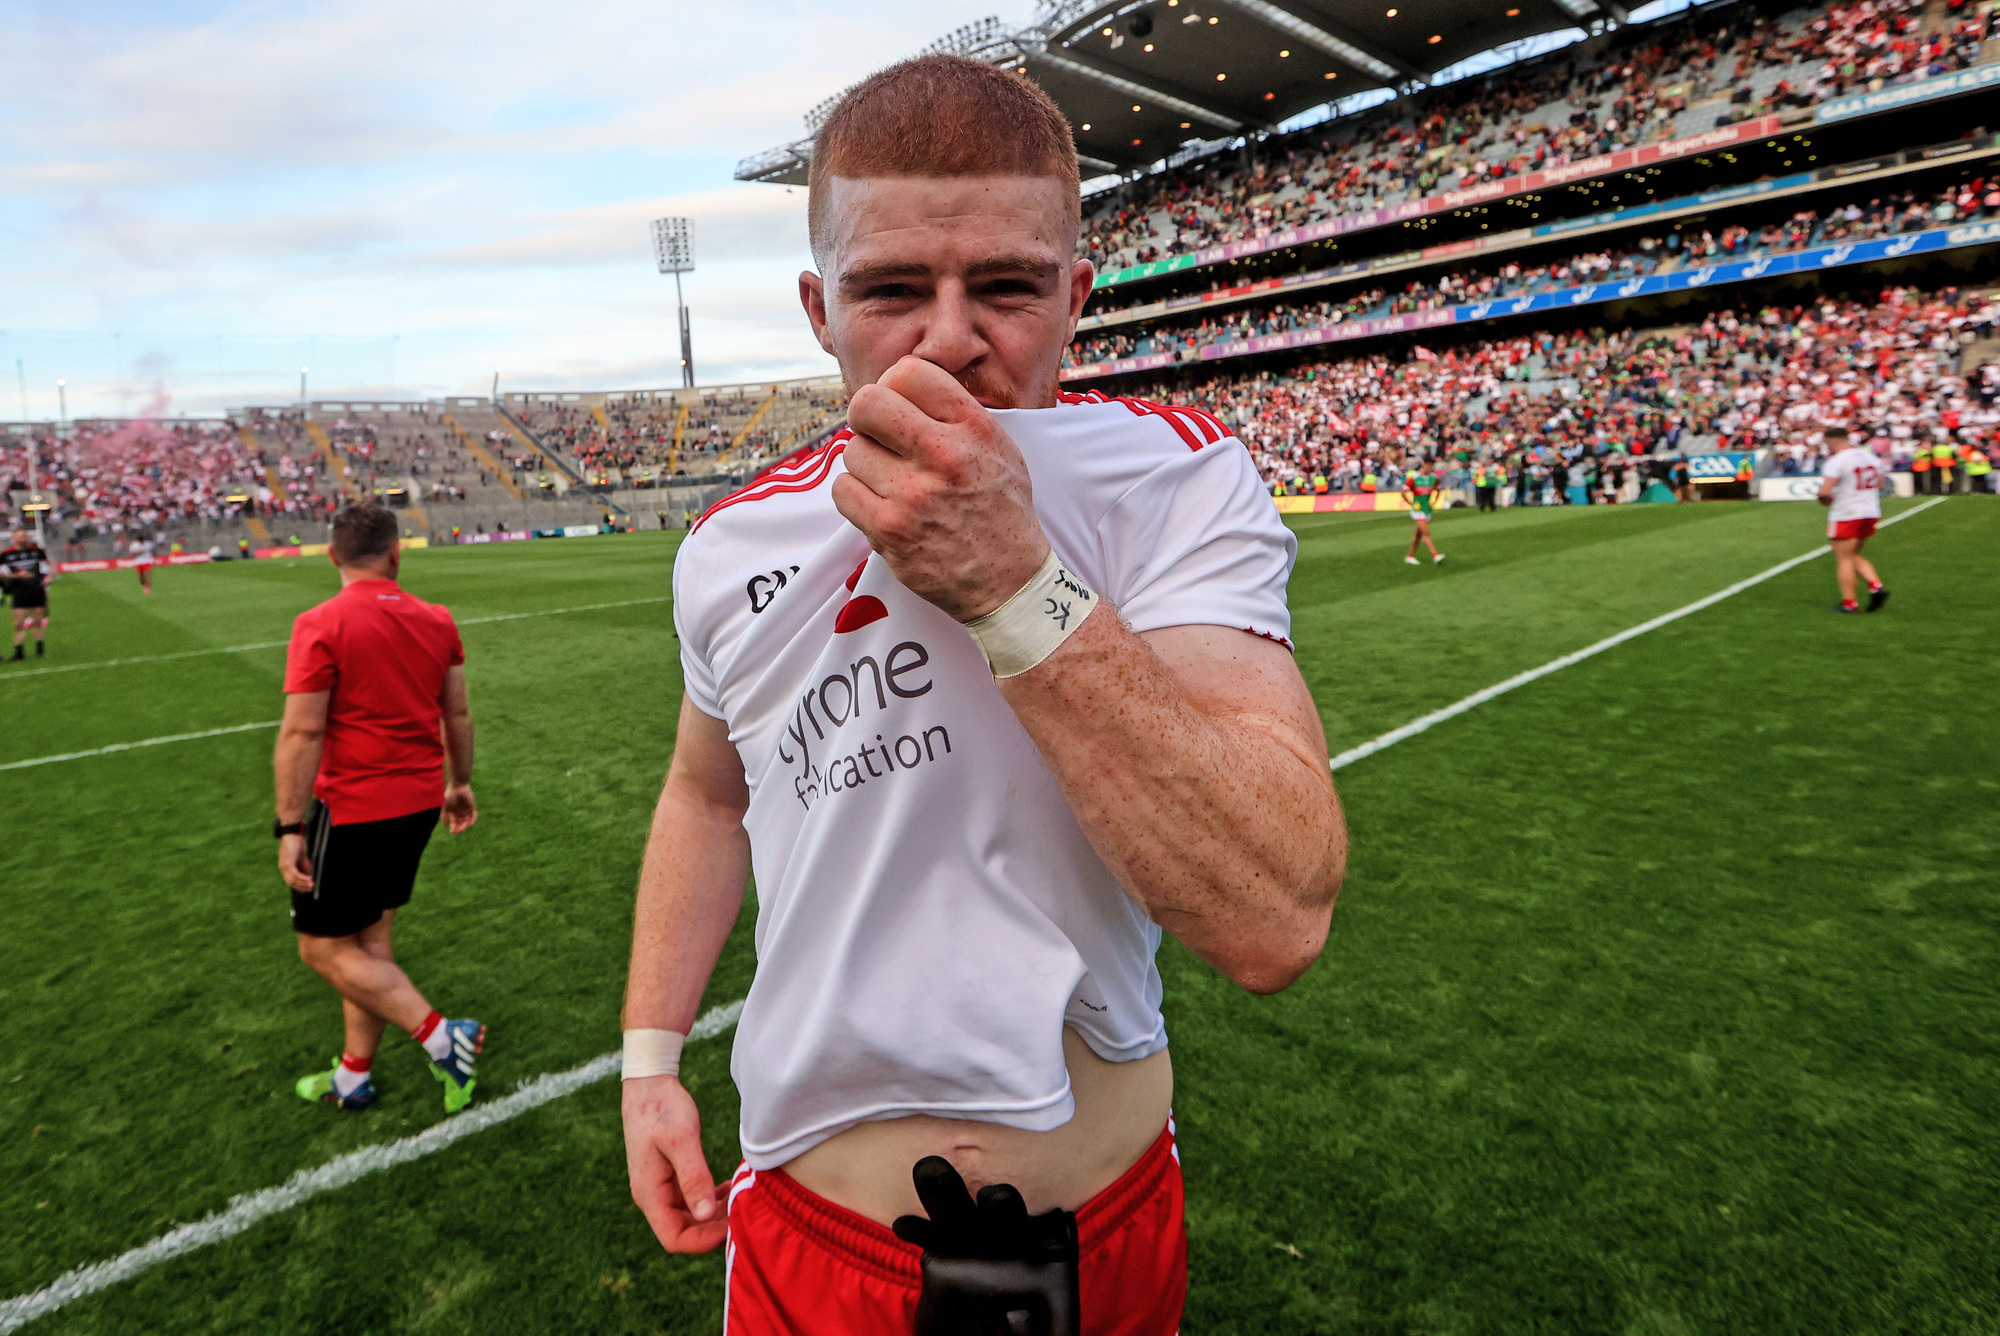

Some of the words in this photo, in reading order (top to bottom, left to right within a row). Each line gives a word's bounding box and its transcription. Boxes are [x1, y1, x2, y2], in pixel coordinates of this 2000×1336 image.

[1820, 100, 1864, 119] GAA
[1658, 127, 1739, 156] SuperValu
[1543, 156, 1612, 183] SuperValu
[1443, 182, 1504, 206] SuperValu
[1688, 455, 1738, 476] GAA
[1853, 465, 1878, 491] 12
